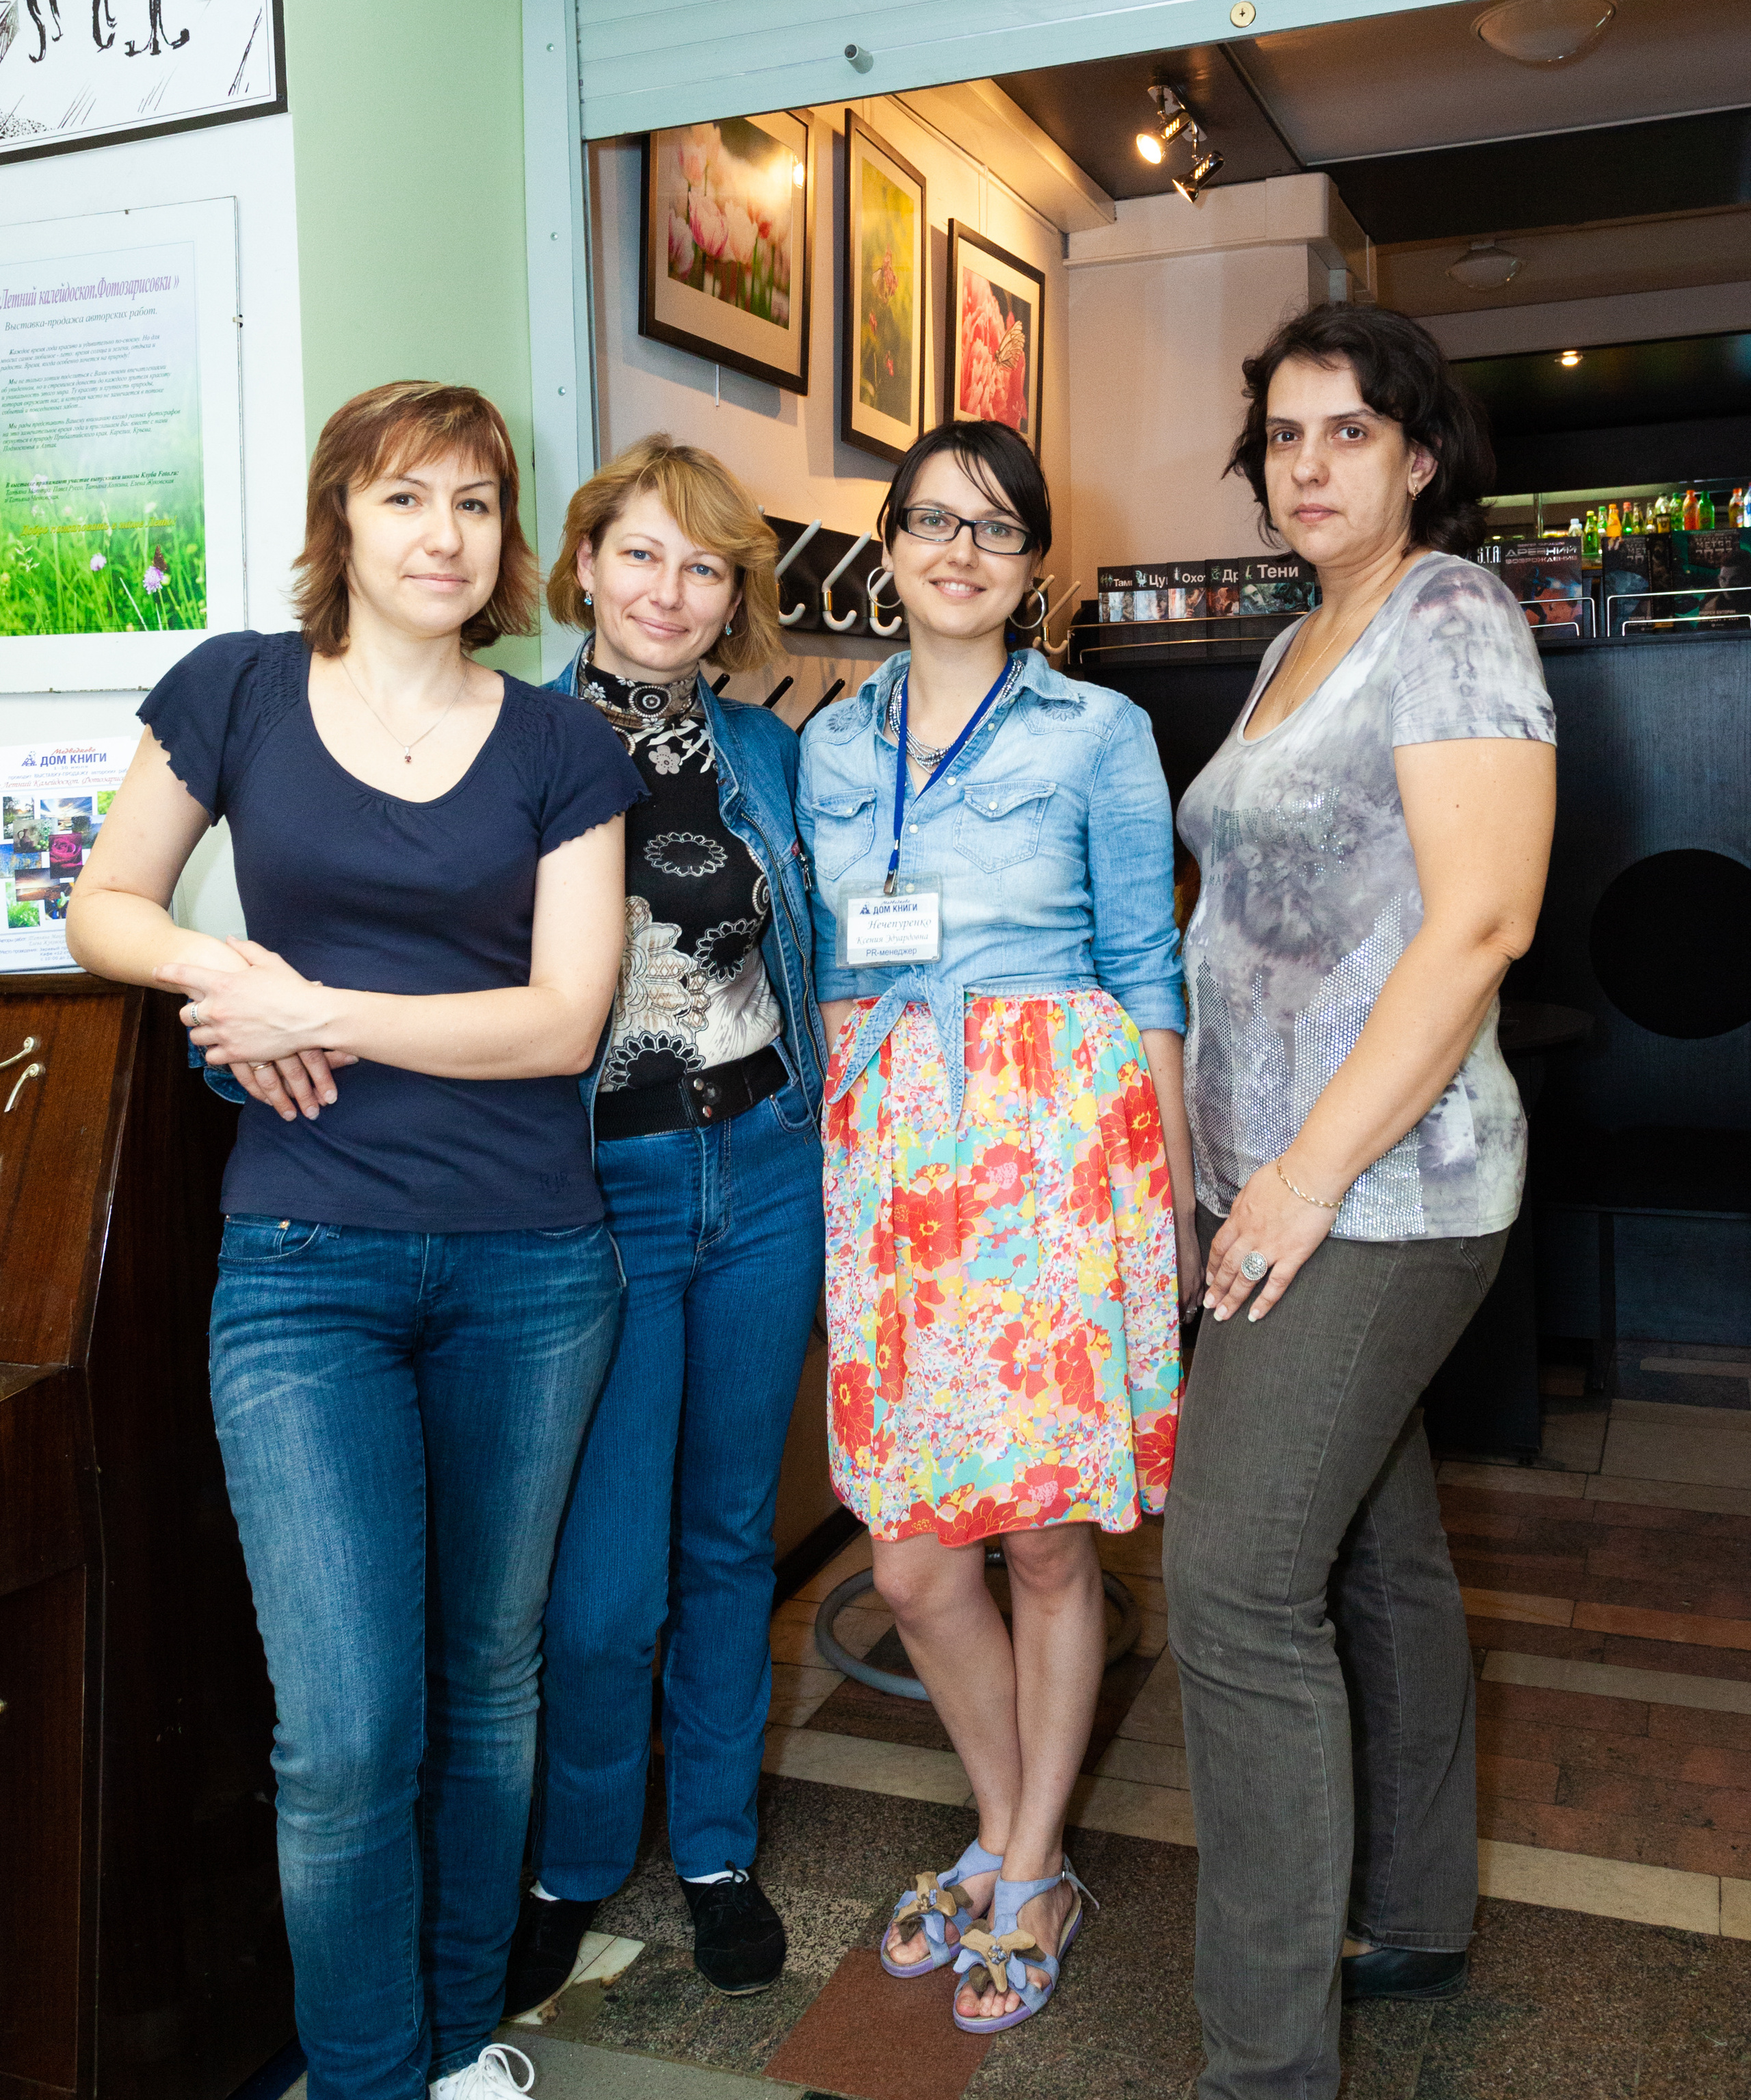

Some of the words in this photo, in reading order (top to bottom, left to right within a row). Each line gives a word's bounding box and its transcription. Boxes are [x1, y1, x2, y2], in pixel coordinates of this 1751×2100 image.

[5, 314, 84, 331] Выставка-продажа
[85, 310, 127, 322] авторских
[129, 306, 158, 320] работ.
[1505, 545, 1577, 557] ДРЕВНИЙ
[1505, 555, 1578, 564] ВОЗРОЖДЕНИЕ
[1256, 564, 1299, 579] Тени
[1182, 573, 1206, 583] Охо
[51, 746, 96, 756] Медведково
[40, 754, 66, 767] ДОМ
[70, 752, 107, 764] КНИГИ
[873, 905, 891, 915] ДОМ
[893, 903, 918, 913] КНИГИ
[867, 918, 932, 931] Нечепуренко
[856, 936, 883, 945] Ксения
[885, 932, 929, 944] Эдуардовна
[866, 947, 917, 957] PR-менеджер
